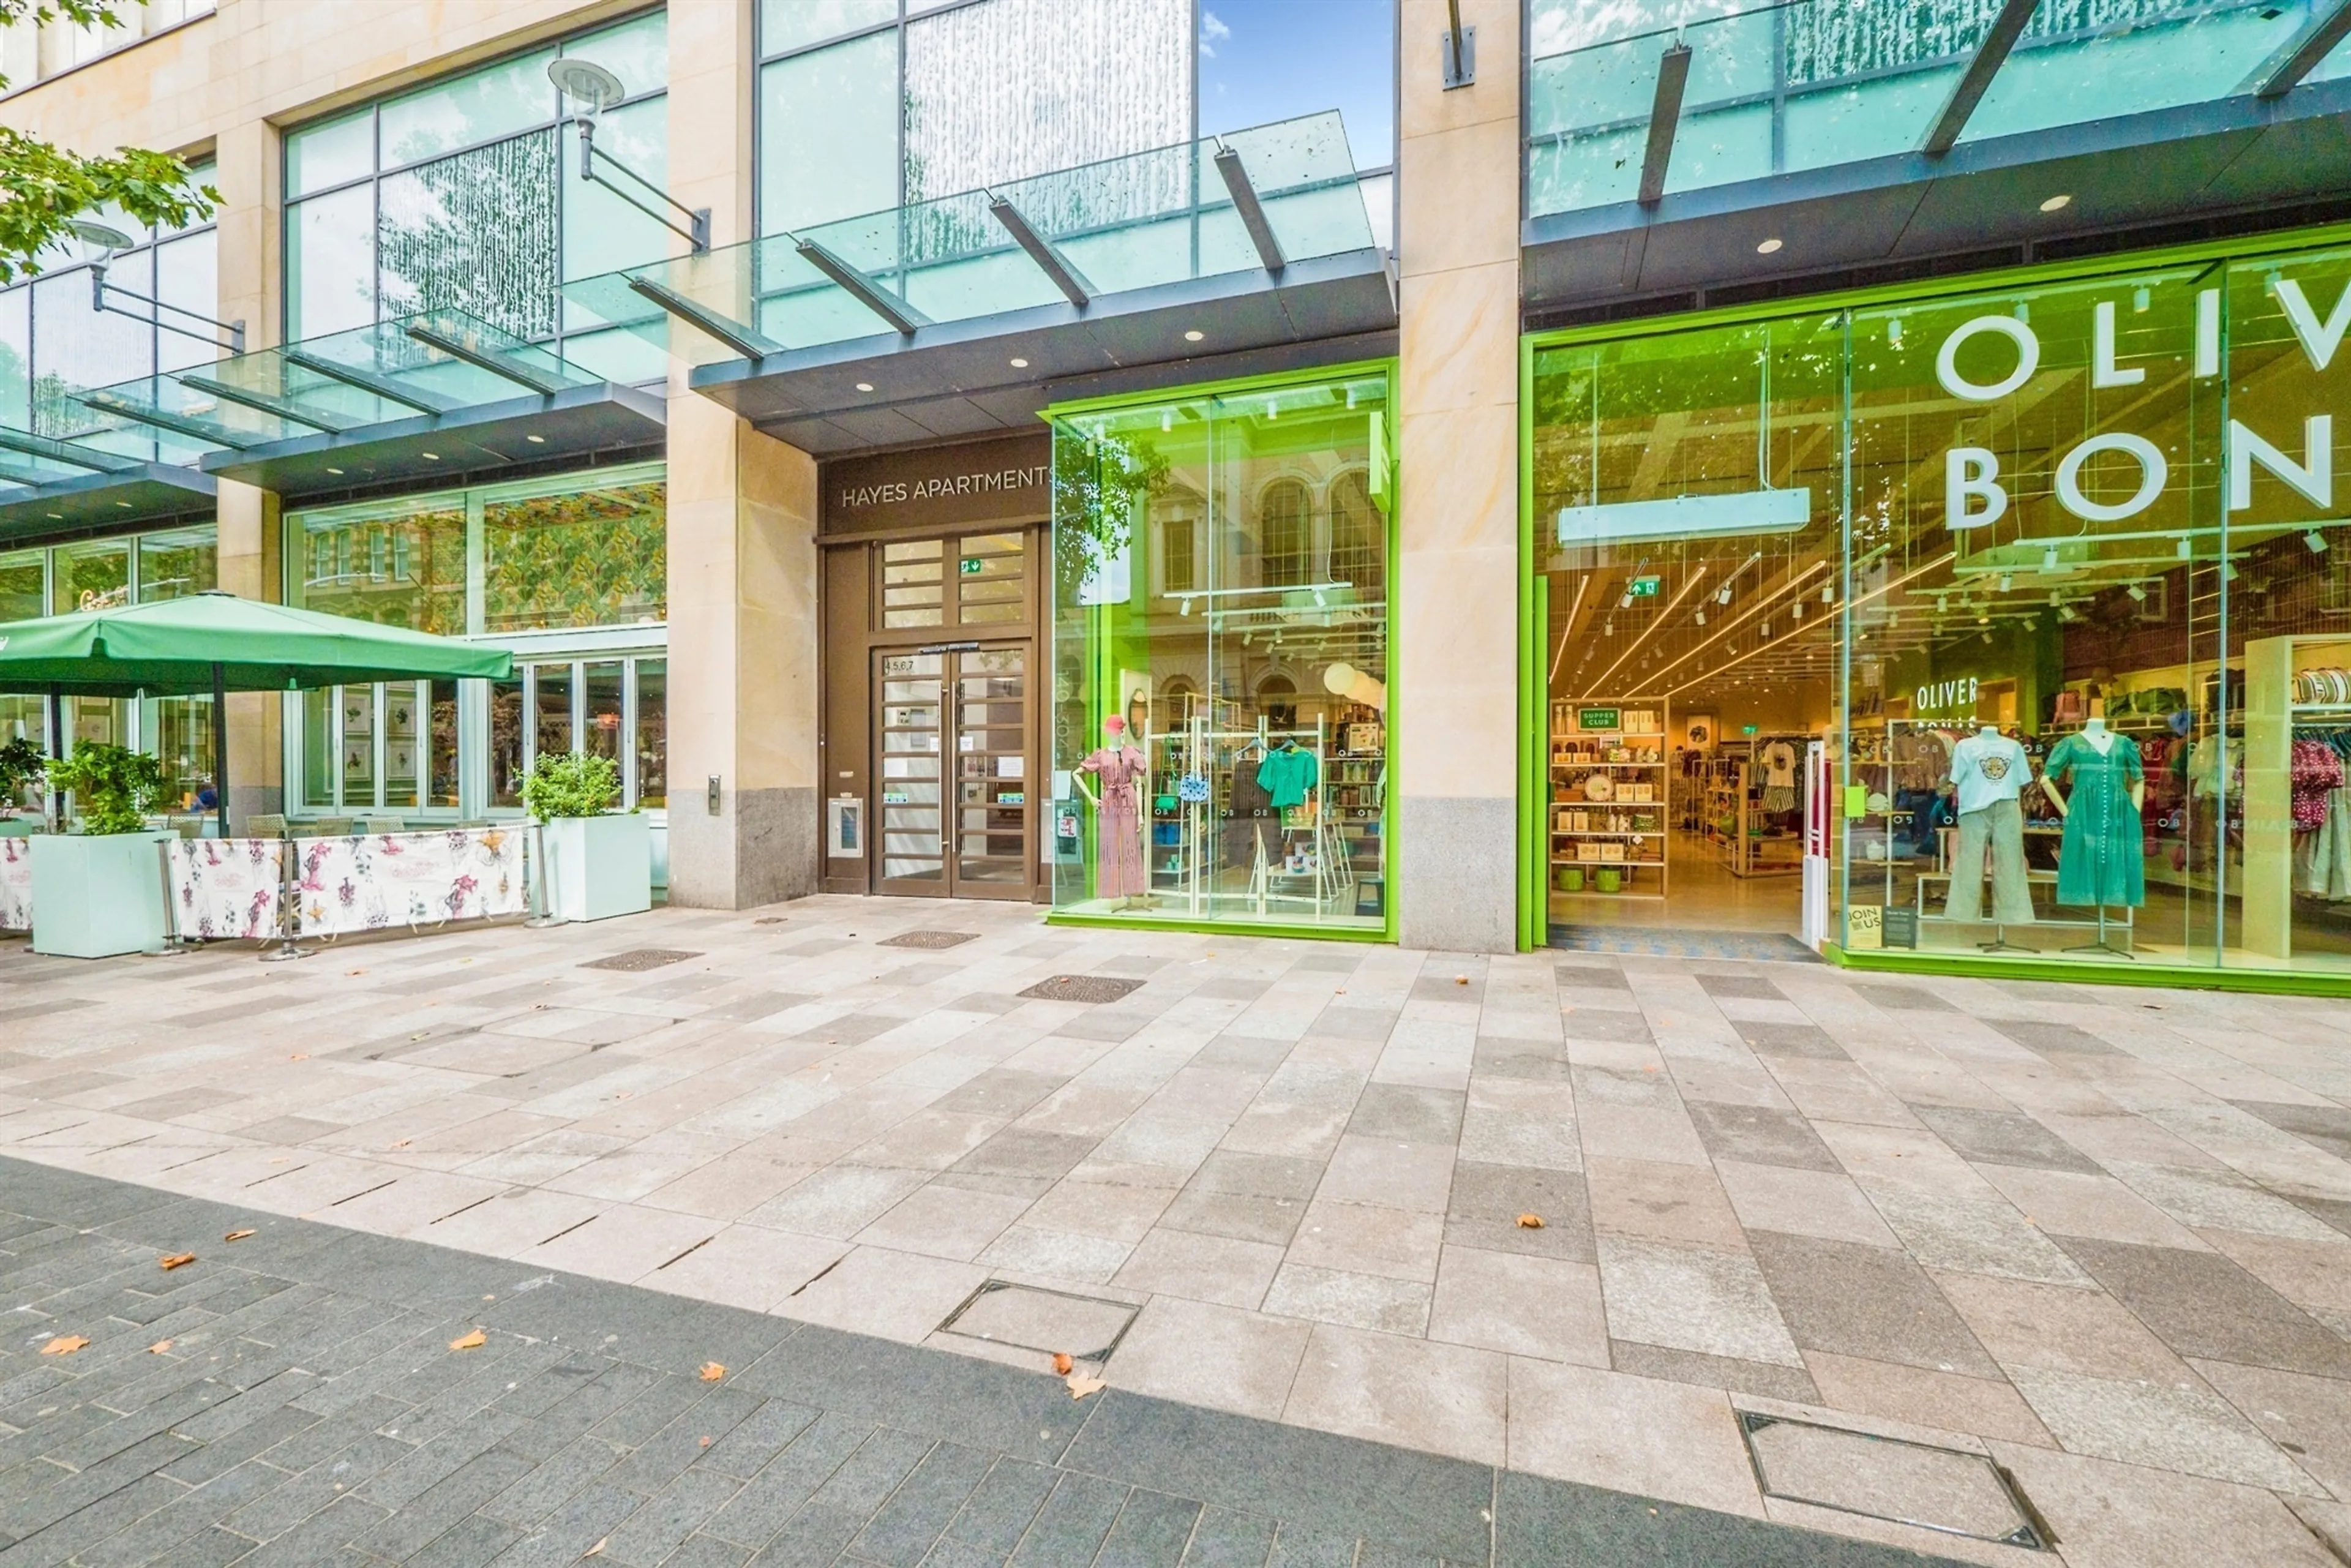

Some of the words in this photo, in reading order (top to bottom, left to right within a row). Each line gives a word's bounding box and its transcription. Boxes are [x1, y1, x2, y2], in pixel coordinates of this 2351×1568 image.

[1935, 279, 2351, 402] OLIV
[1945, 415, 2332, 531] BON
[842, 484, 907, 508] HAYES
[1917, 677, 1978, 711] OLIVER
[1848, 907, 1877, 921] JOIN
[1864, 917, 1881, 928] US
